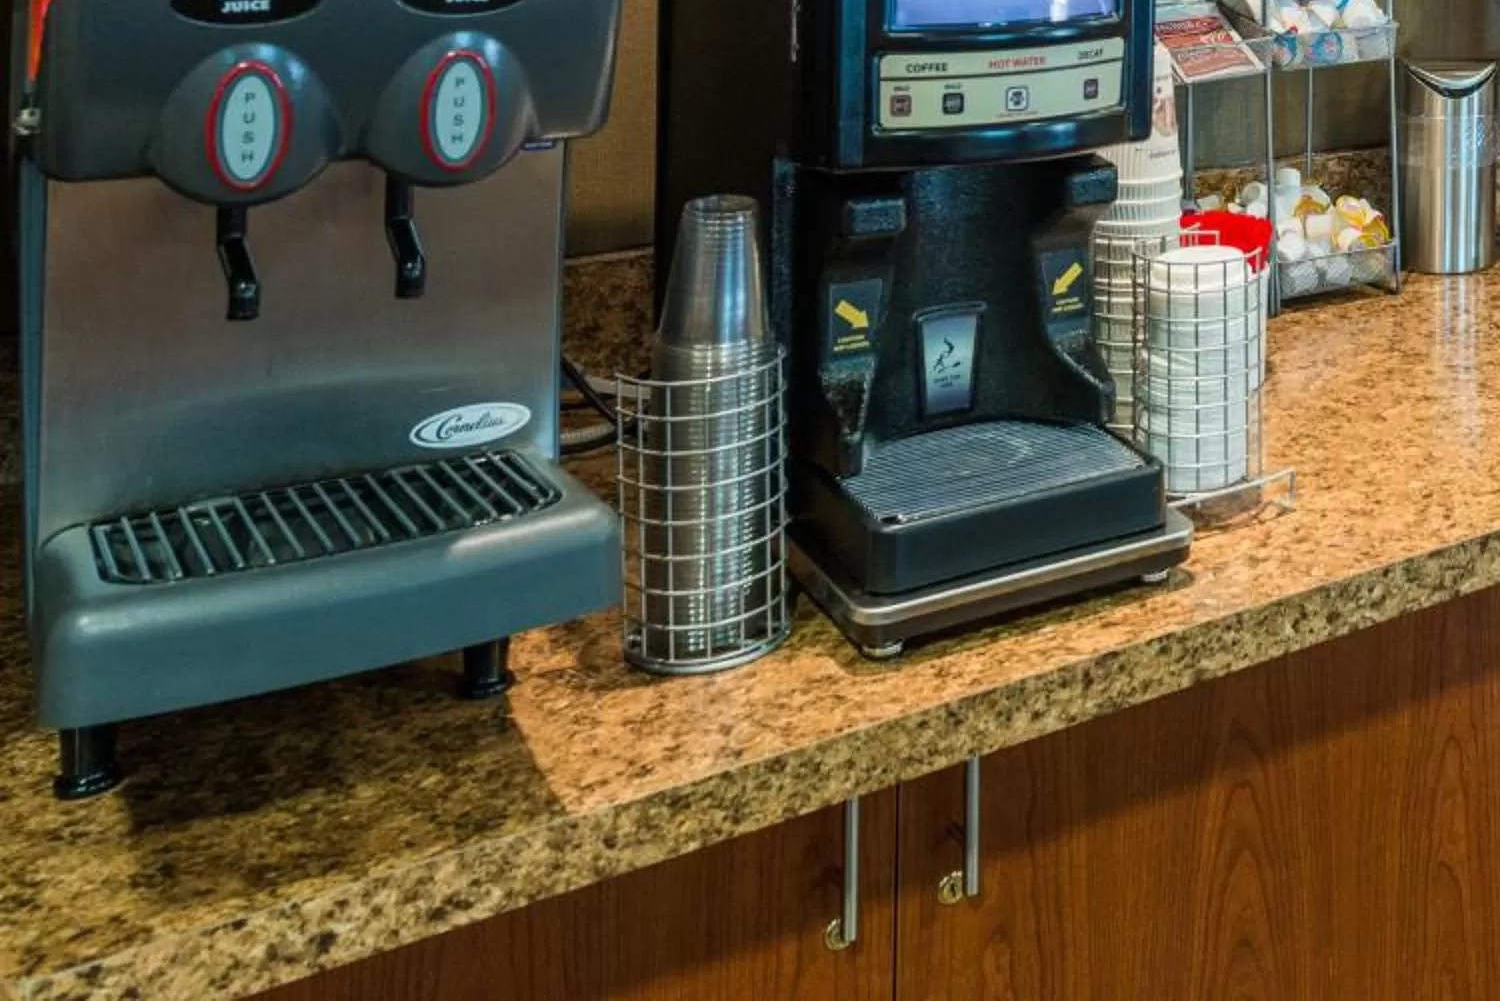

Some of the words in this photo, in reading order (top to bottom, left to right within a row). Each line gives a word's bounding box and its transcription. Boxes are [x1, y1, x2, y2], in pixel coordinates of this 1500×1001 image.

[906, 62, 949, 74] COFFEE
[988, 58, 1011, 70] HOT
[1012, 55, 1046, 68] WATER
[241, 92, 256, 164] PUSH
[451, 77, 465, 145] PUSH
